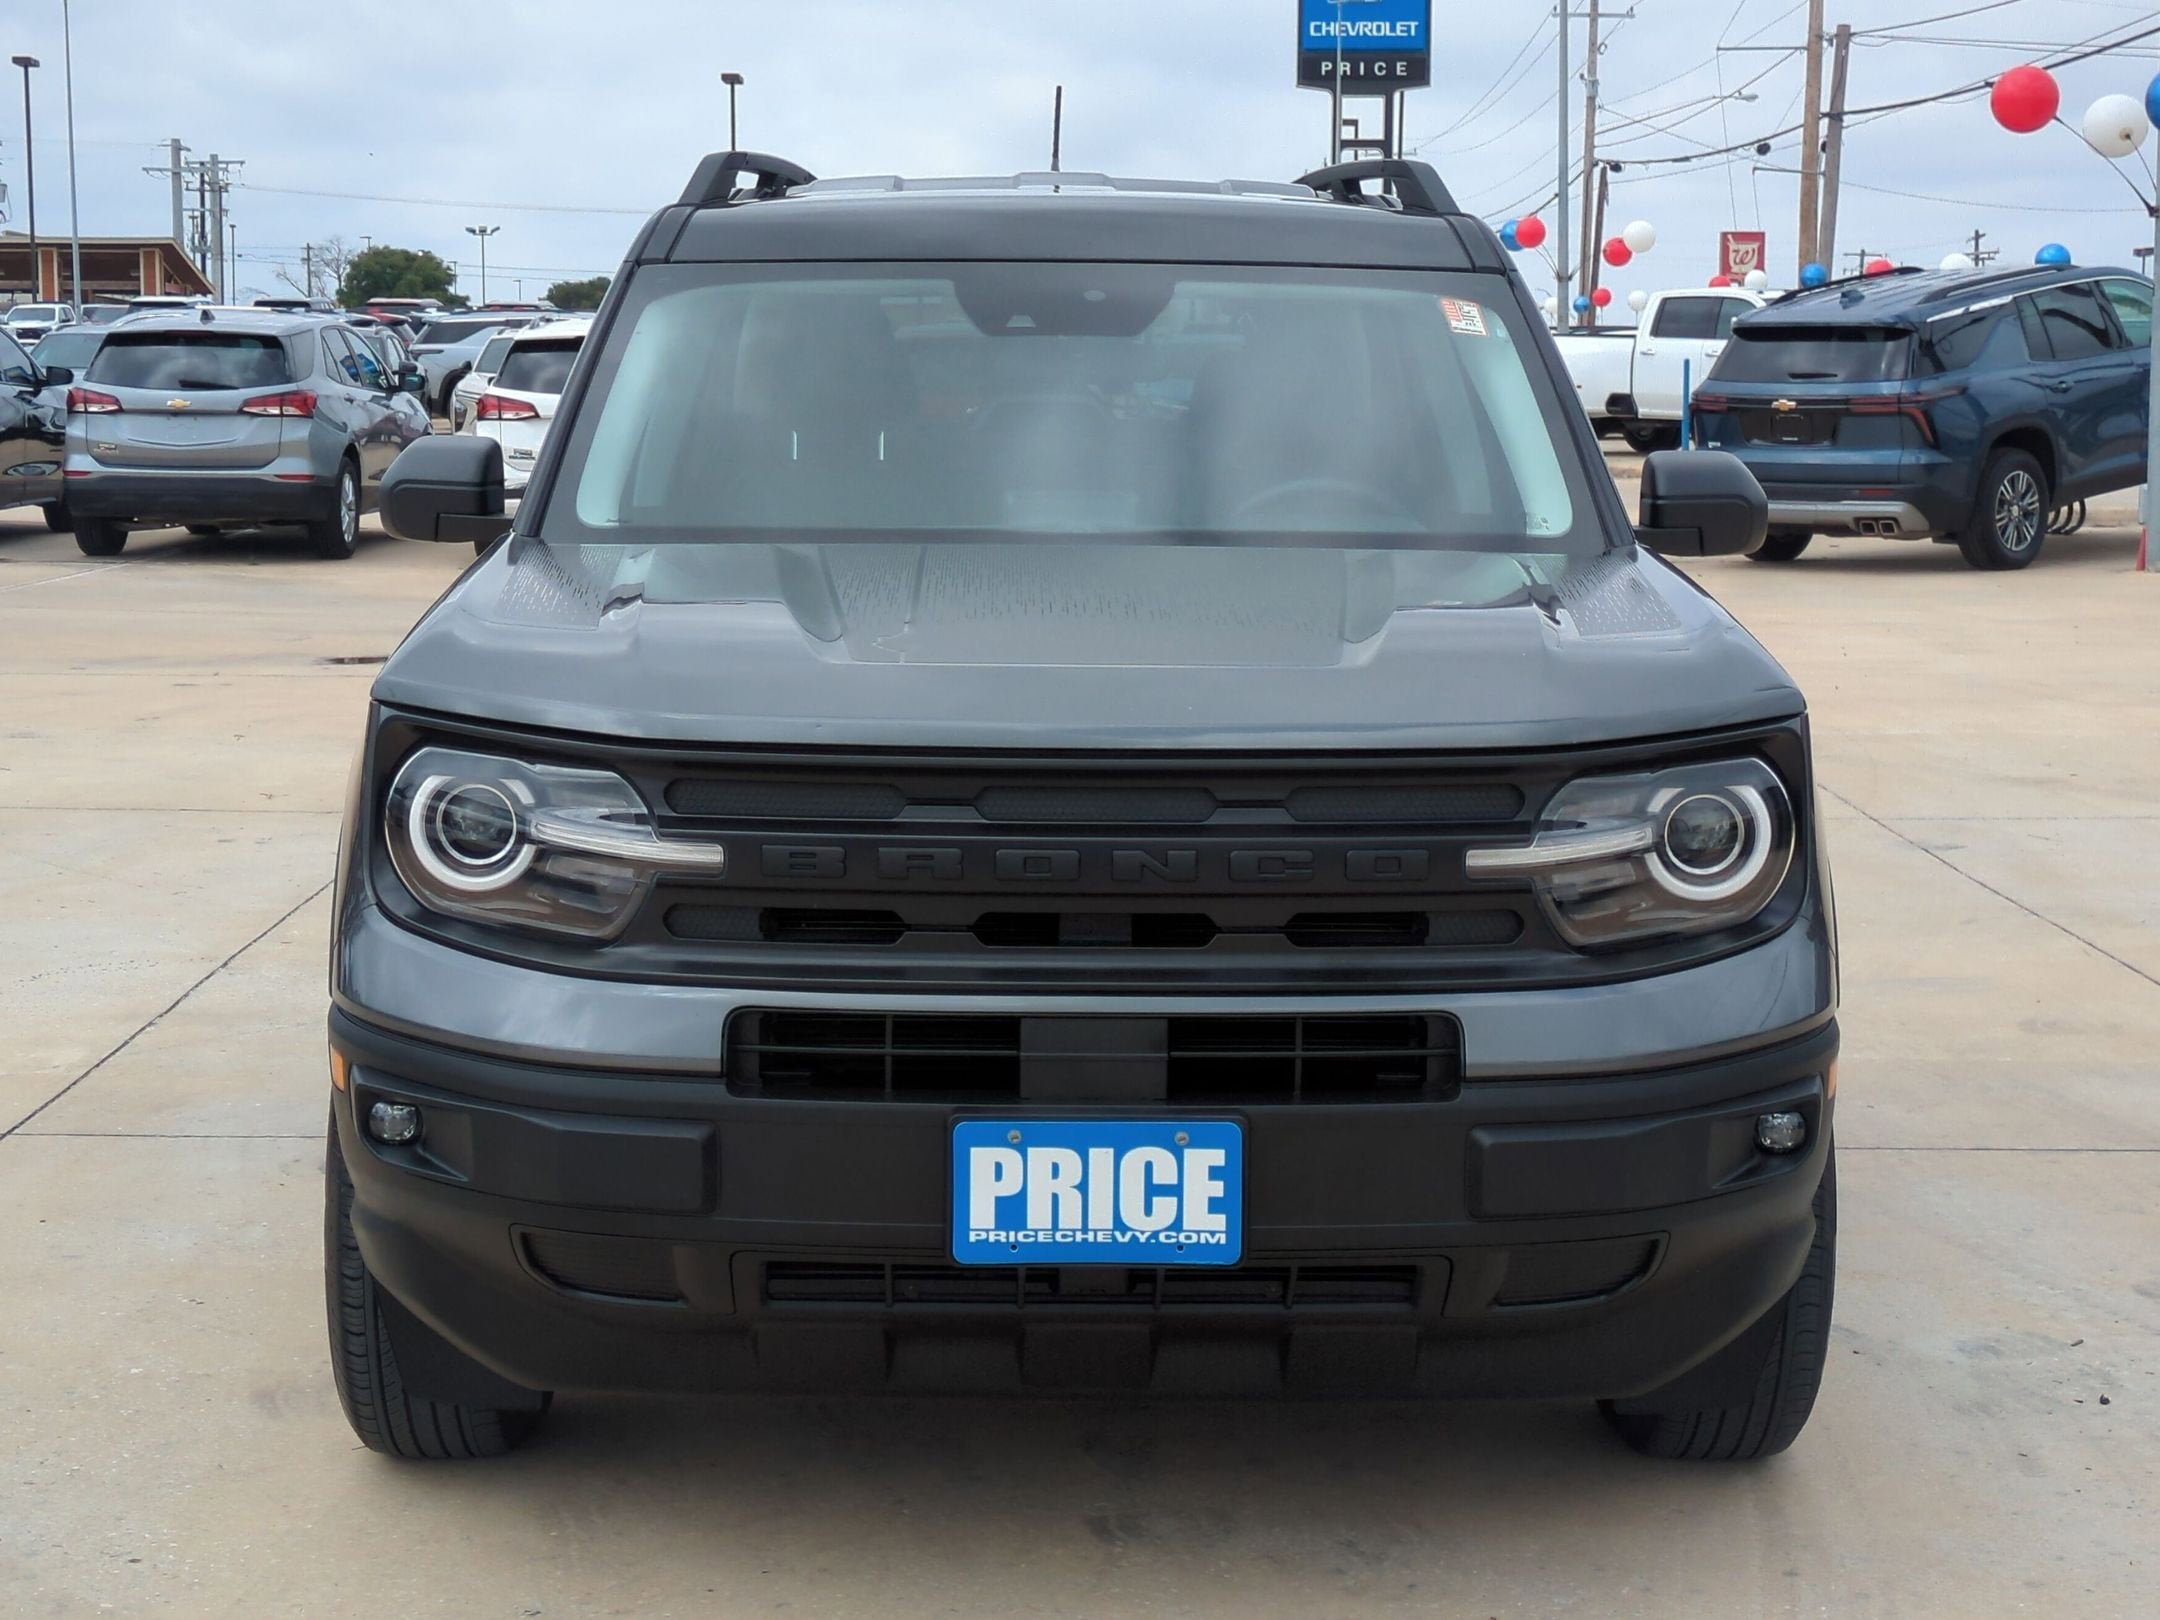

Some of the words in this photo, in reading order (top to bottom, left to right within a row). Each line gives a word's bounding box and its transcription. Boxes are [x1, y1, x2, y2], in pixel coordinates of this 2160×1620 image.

[1309, 21, 1419, 37] CHEVROLET
[1320, 61, 1408, 77] PRICE
[760, 843, 1430, 883] BRONCO
[968, 1146, 1227, 1232] PRICE
[968, 1230, 1227, 1245] PRICECHEVY.COM
